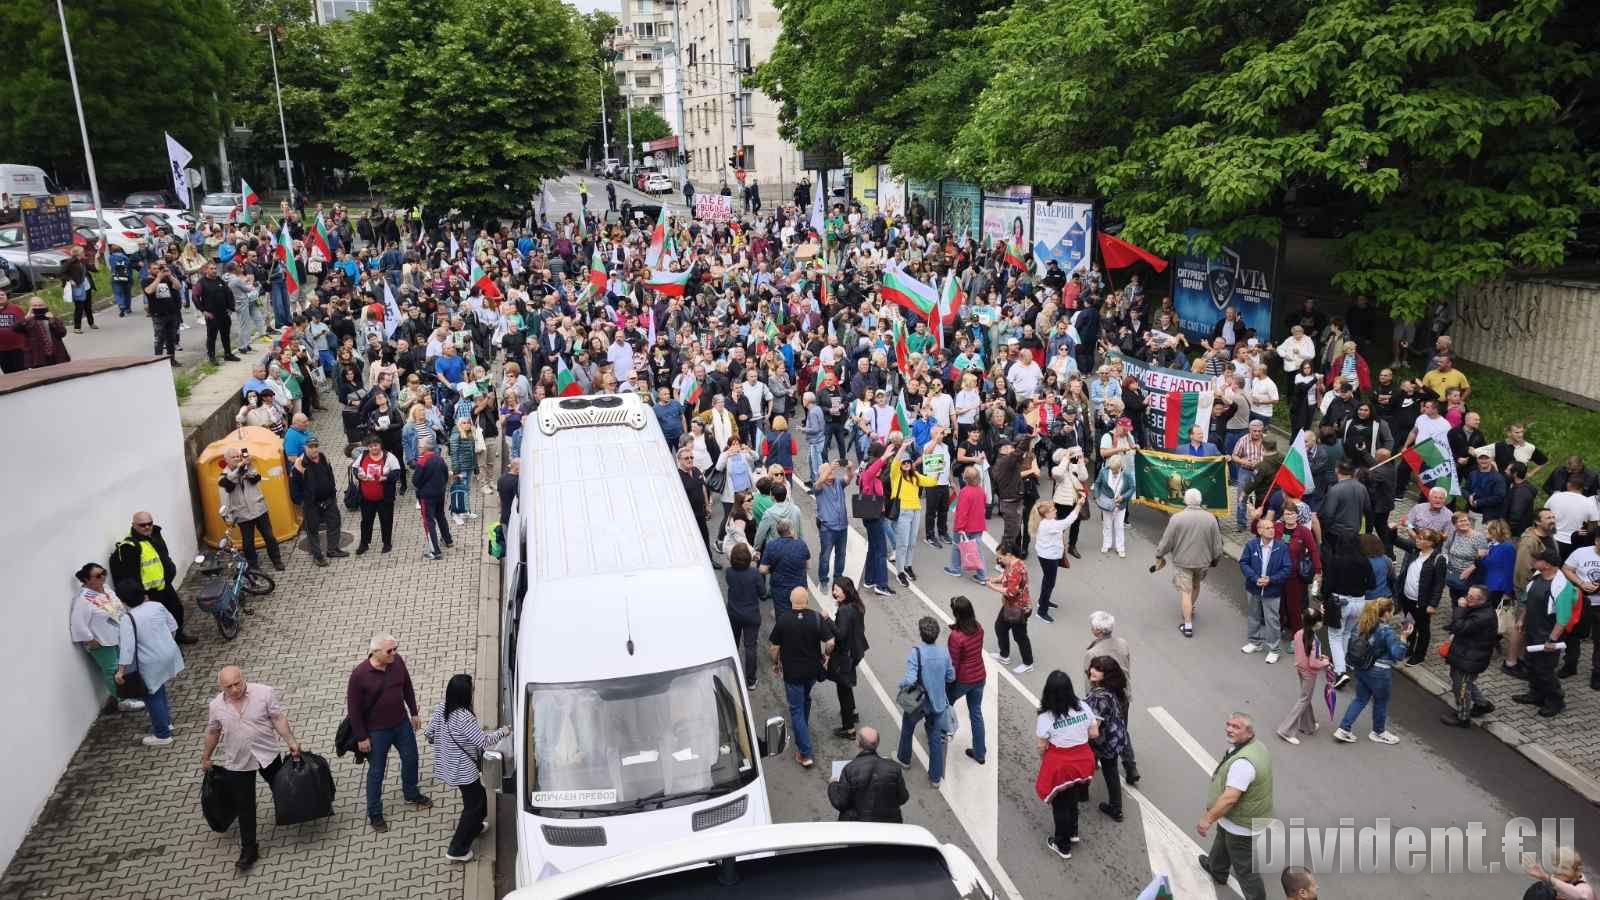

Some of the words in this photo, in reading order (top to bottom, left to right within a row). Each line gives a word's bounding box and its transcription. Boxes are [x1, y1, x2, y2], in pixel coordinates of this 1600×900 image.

[1177, 268, 1207, 281] СИГУРНОСТ
[1240, 269, 1268, 291] VTA
[1182, 279, 1203, 291] ОХРАНА
[534, 791, 577, 802] СЛУЧАЕН
[579, 791, 615, 801] ПРЕВОЗ
